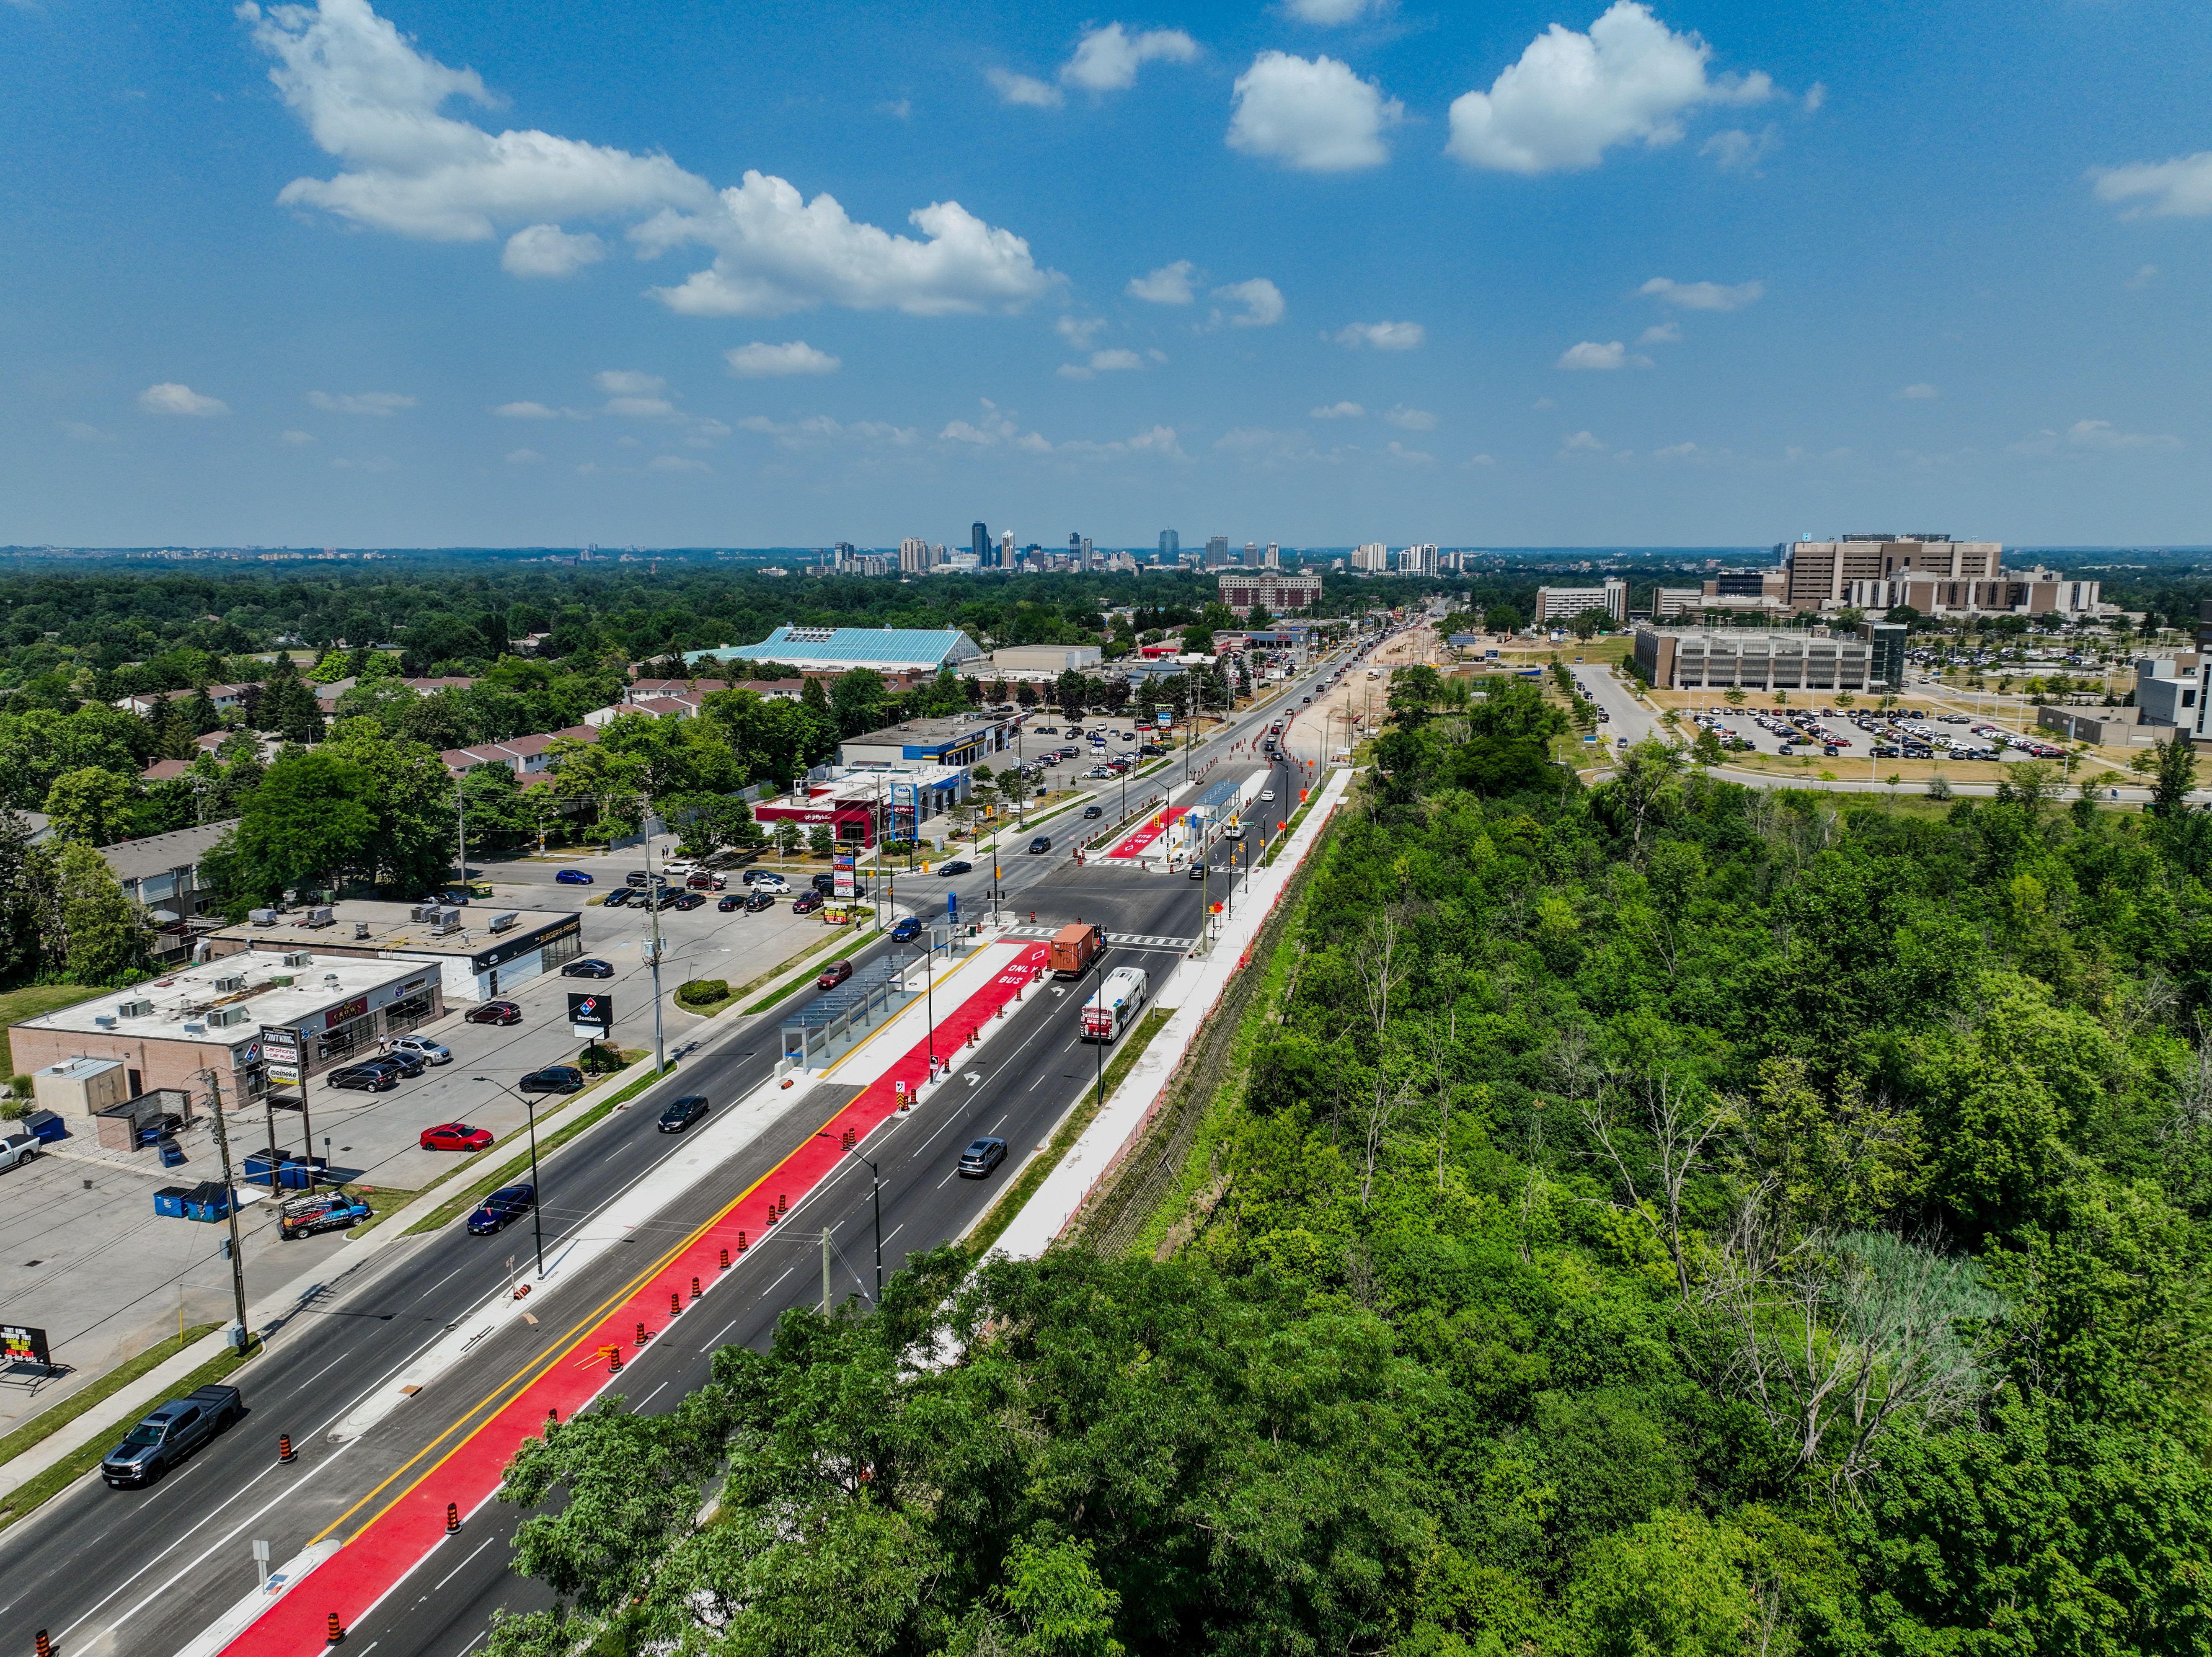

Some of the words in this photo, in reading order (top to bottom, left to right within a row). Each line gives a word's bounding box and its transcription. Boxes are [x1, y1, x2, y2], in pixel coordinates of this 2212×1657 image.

[1008, 965, 1039, 973] ONLY
[998, 976, 1023, 984] BUS
[334, 1005, 361, 1019] CROWN
[264, 1033, 279, 1042] TINT
[279, 1035, 295, 1044] KING
[270, 1069, 297, 1078] meineke
